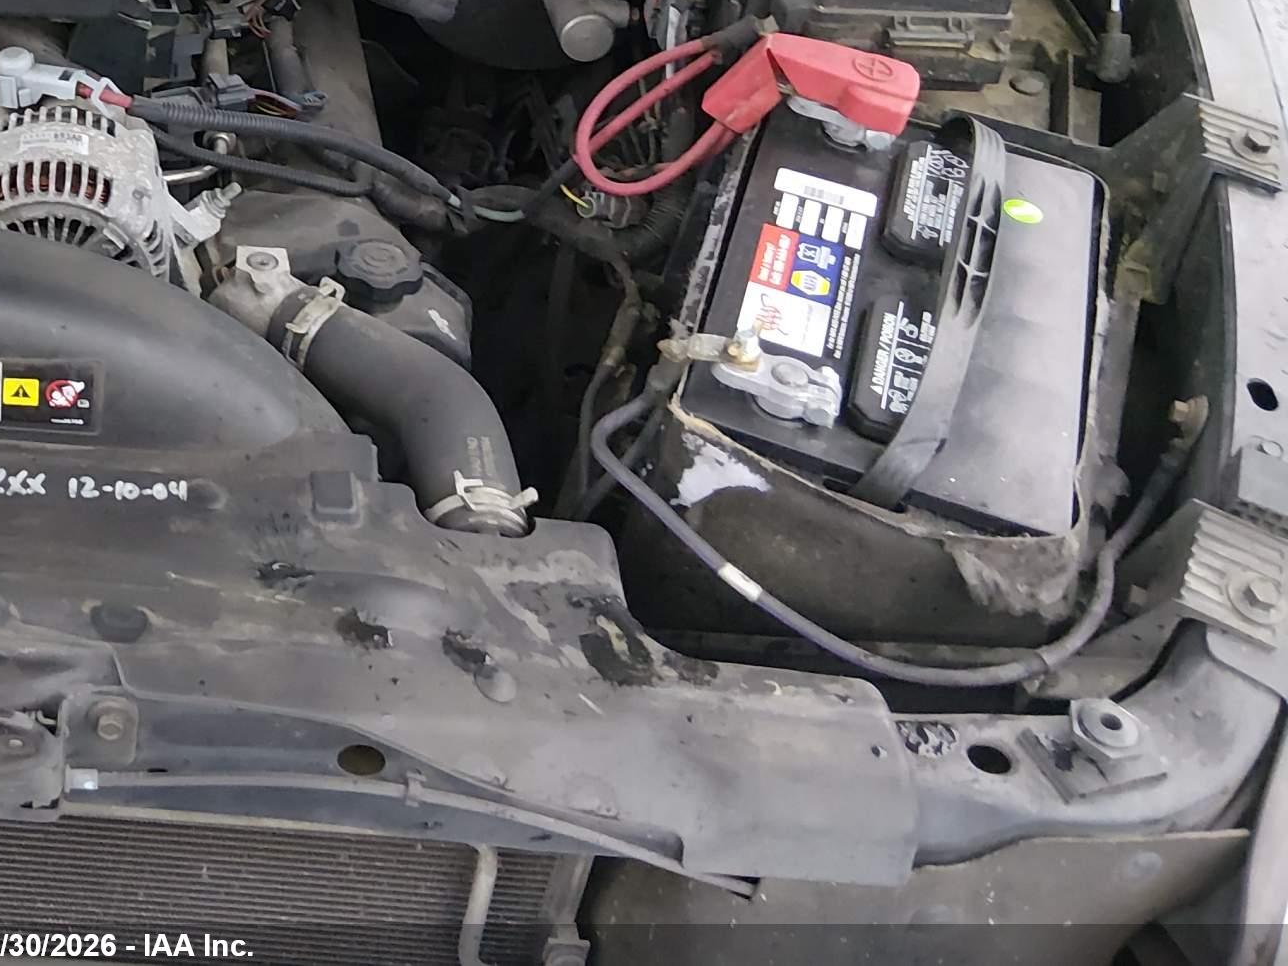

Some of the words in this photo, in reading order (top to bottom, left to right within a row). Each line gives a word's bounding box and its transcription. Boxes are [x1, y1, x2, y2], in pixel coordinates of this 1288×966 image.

[877, 311, 897, 345] POISON
[871, 349, 890, 385] DANGER
[68, 476, 188, 502] 12-10-04
